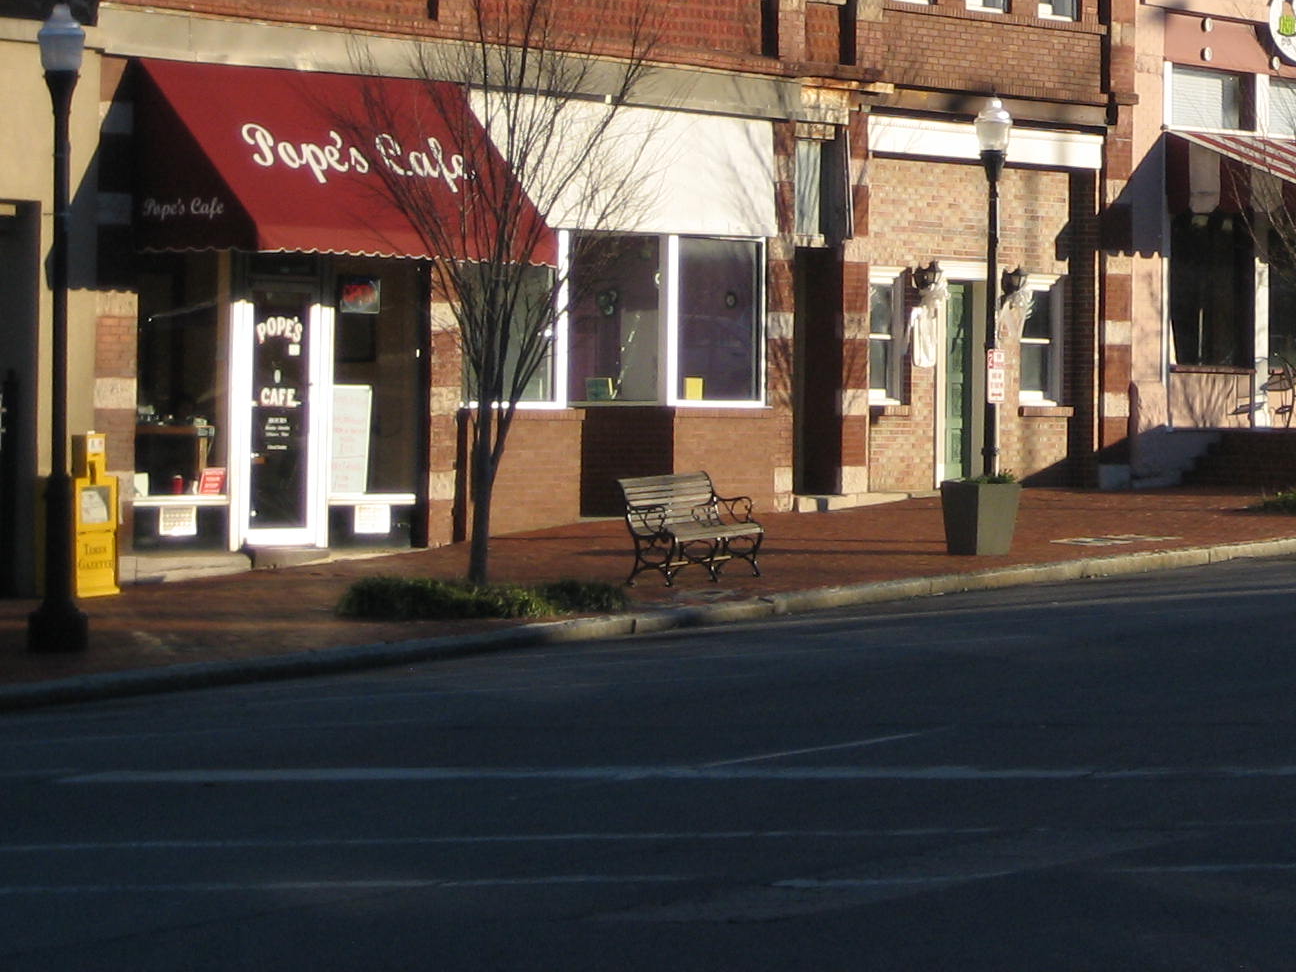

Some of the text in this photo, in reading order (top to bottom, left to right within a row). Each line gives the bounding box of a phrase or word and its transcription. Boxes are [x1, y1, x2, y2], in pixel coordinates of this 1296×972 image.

[241, 123, 476, 193] Pope's Cafe
[142, 196, 225, 221] Pope's Cafe
[256, 316, 303, 344] POPE'S
[260, 387, 299, 408] CAFE
